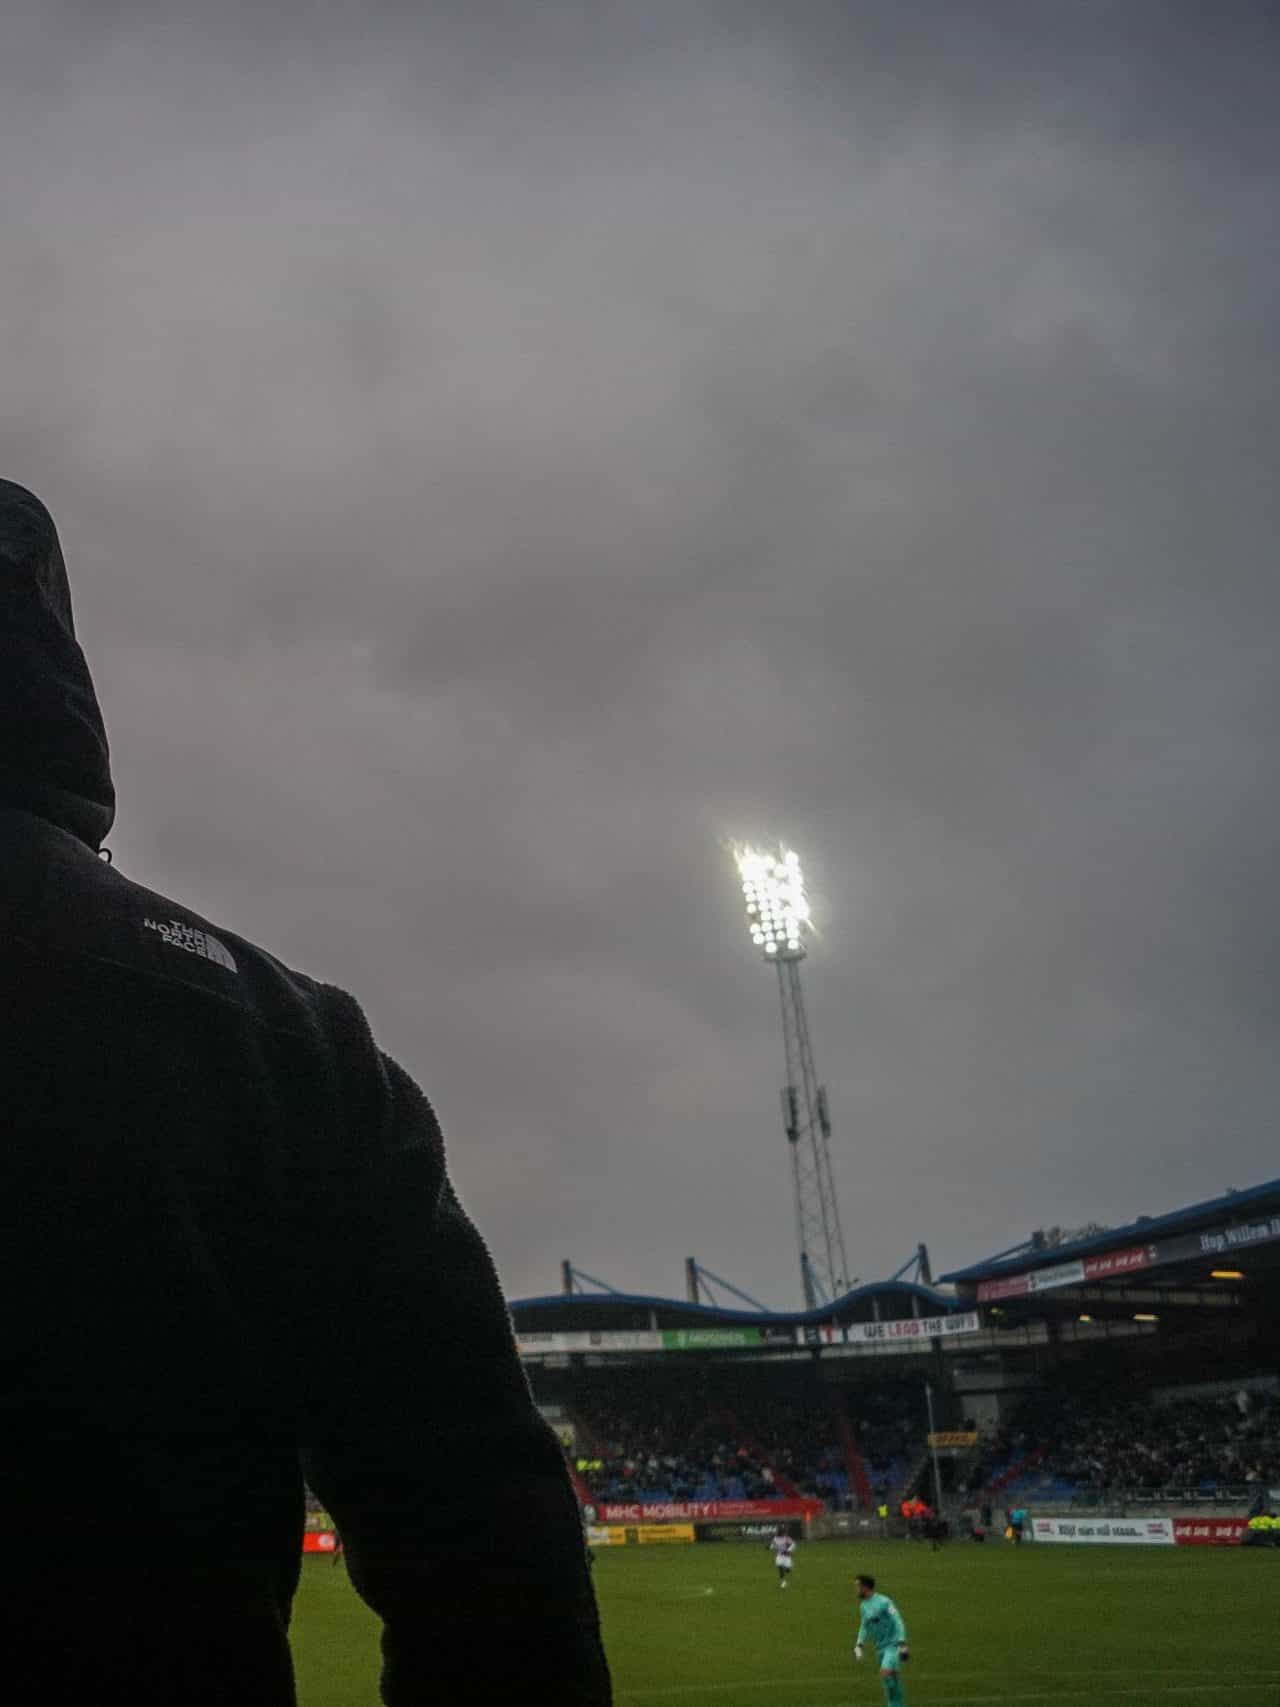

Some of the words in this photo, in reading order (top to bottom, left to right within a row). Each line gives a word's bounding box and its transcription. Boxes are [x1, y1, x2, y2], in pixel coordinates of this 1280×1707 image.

[144, 918, 206, 945] NORTH
[169, 920, 204, 938] THE
[162, 935, 208, 958] FACE
[864, 1324, 885, 1338] WE
[606, 1504, 640, 1520] MHC
[643, 1502, 711, 1518] MOBILITY
